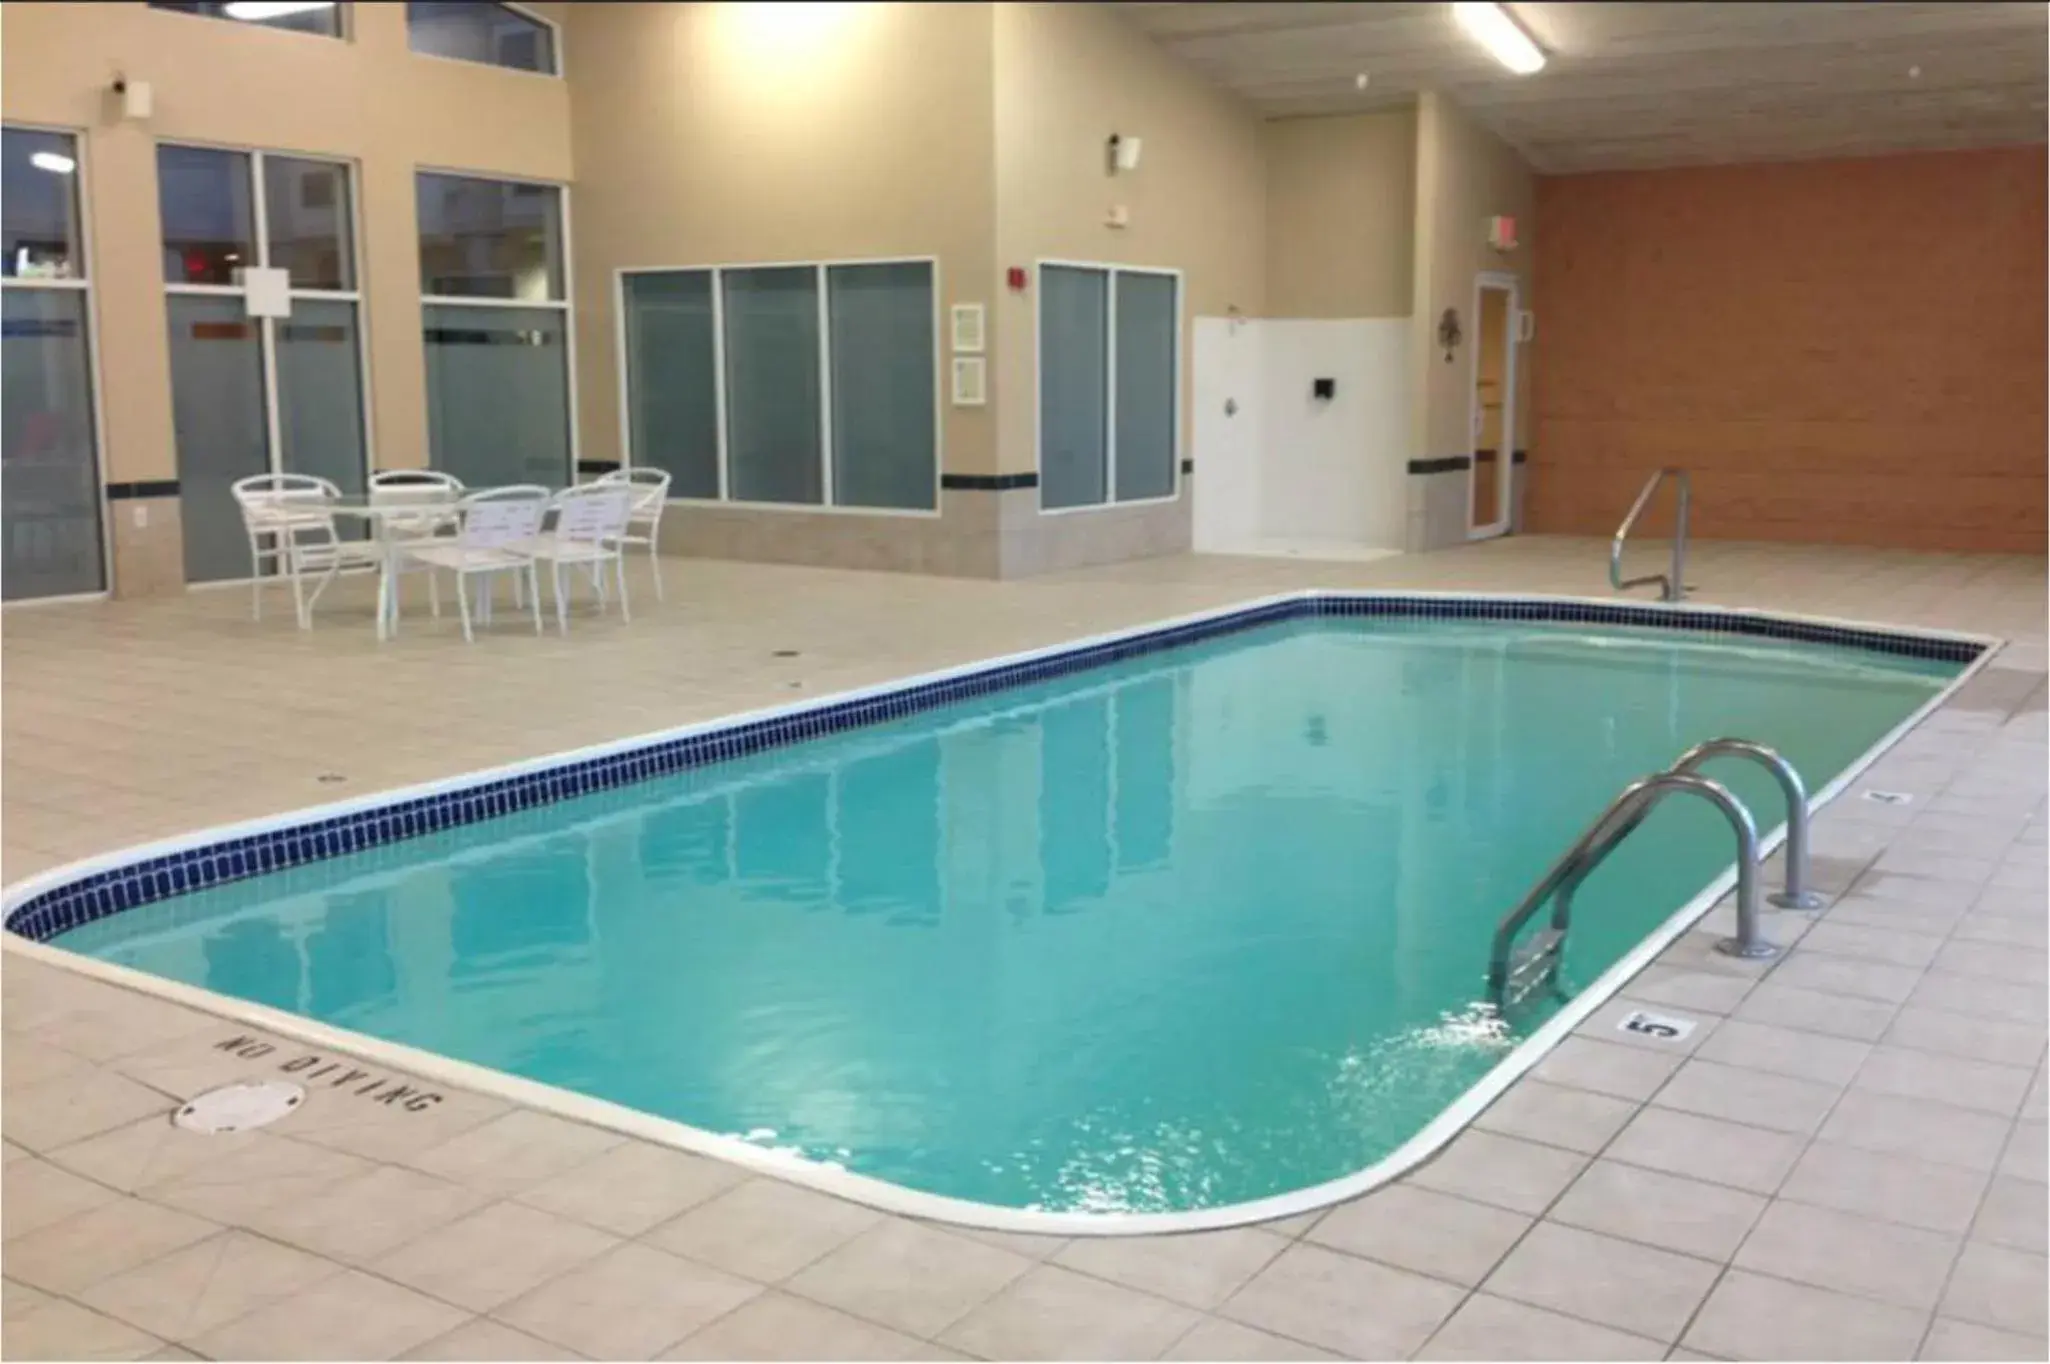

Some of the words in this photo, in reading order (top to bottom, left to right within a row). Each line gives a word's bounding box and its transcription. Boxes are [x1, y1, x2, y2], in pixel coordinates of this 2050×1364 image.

[1626, 1013, 1679, 1037] 5
[213, 1035, 277, 1060] NO
[278, 1055, 444, 1113] DIVING
